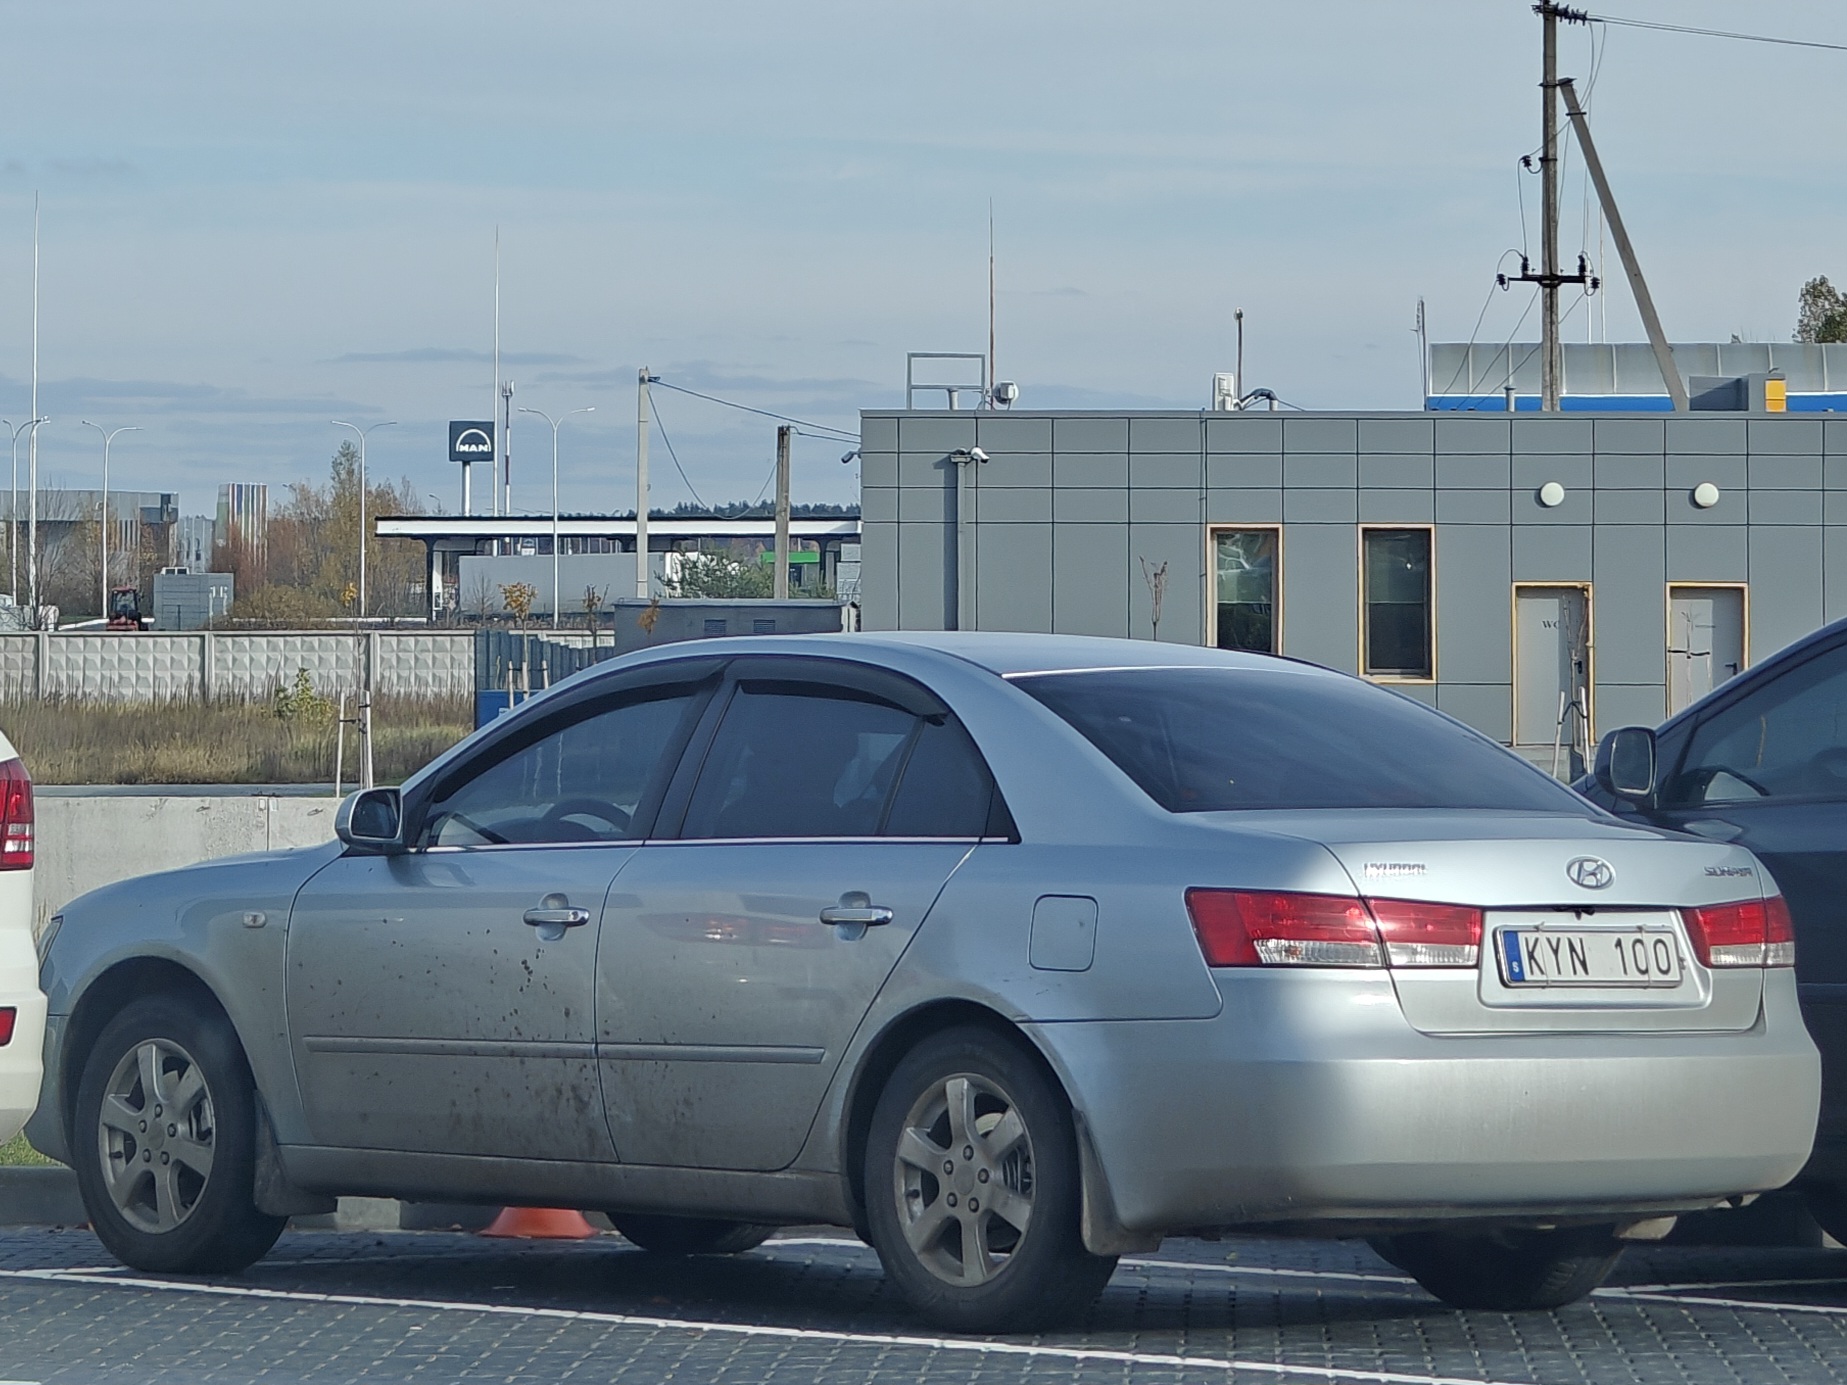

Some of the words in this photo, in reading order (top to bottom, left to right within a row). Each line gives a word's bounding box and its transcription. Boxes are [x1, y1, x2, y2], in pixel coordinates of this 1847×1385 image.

[459, 444, 488, 452] MAN
[1525, 936, 1589, 976] KYN
[1614, 937, 1671, 976] 100
[1512, 961, 1519, 973] S
